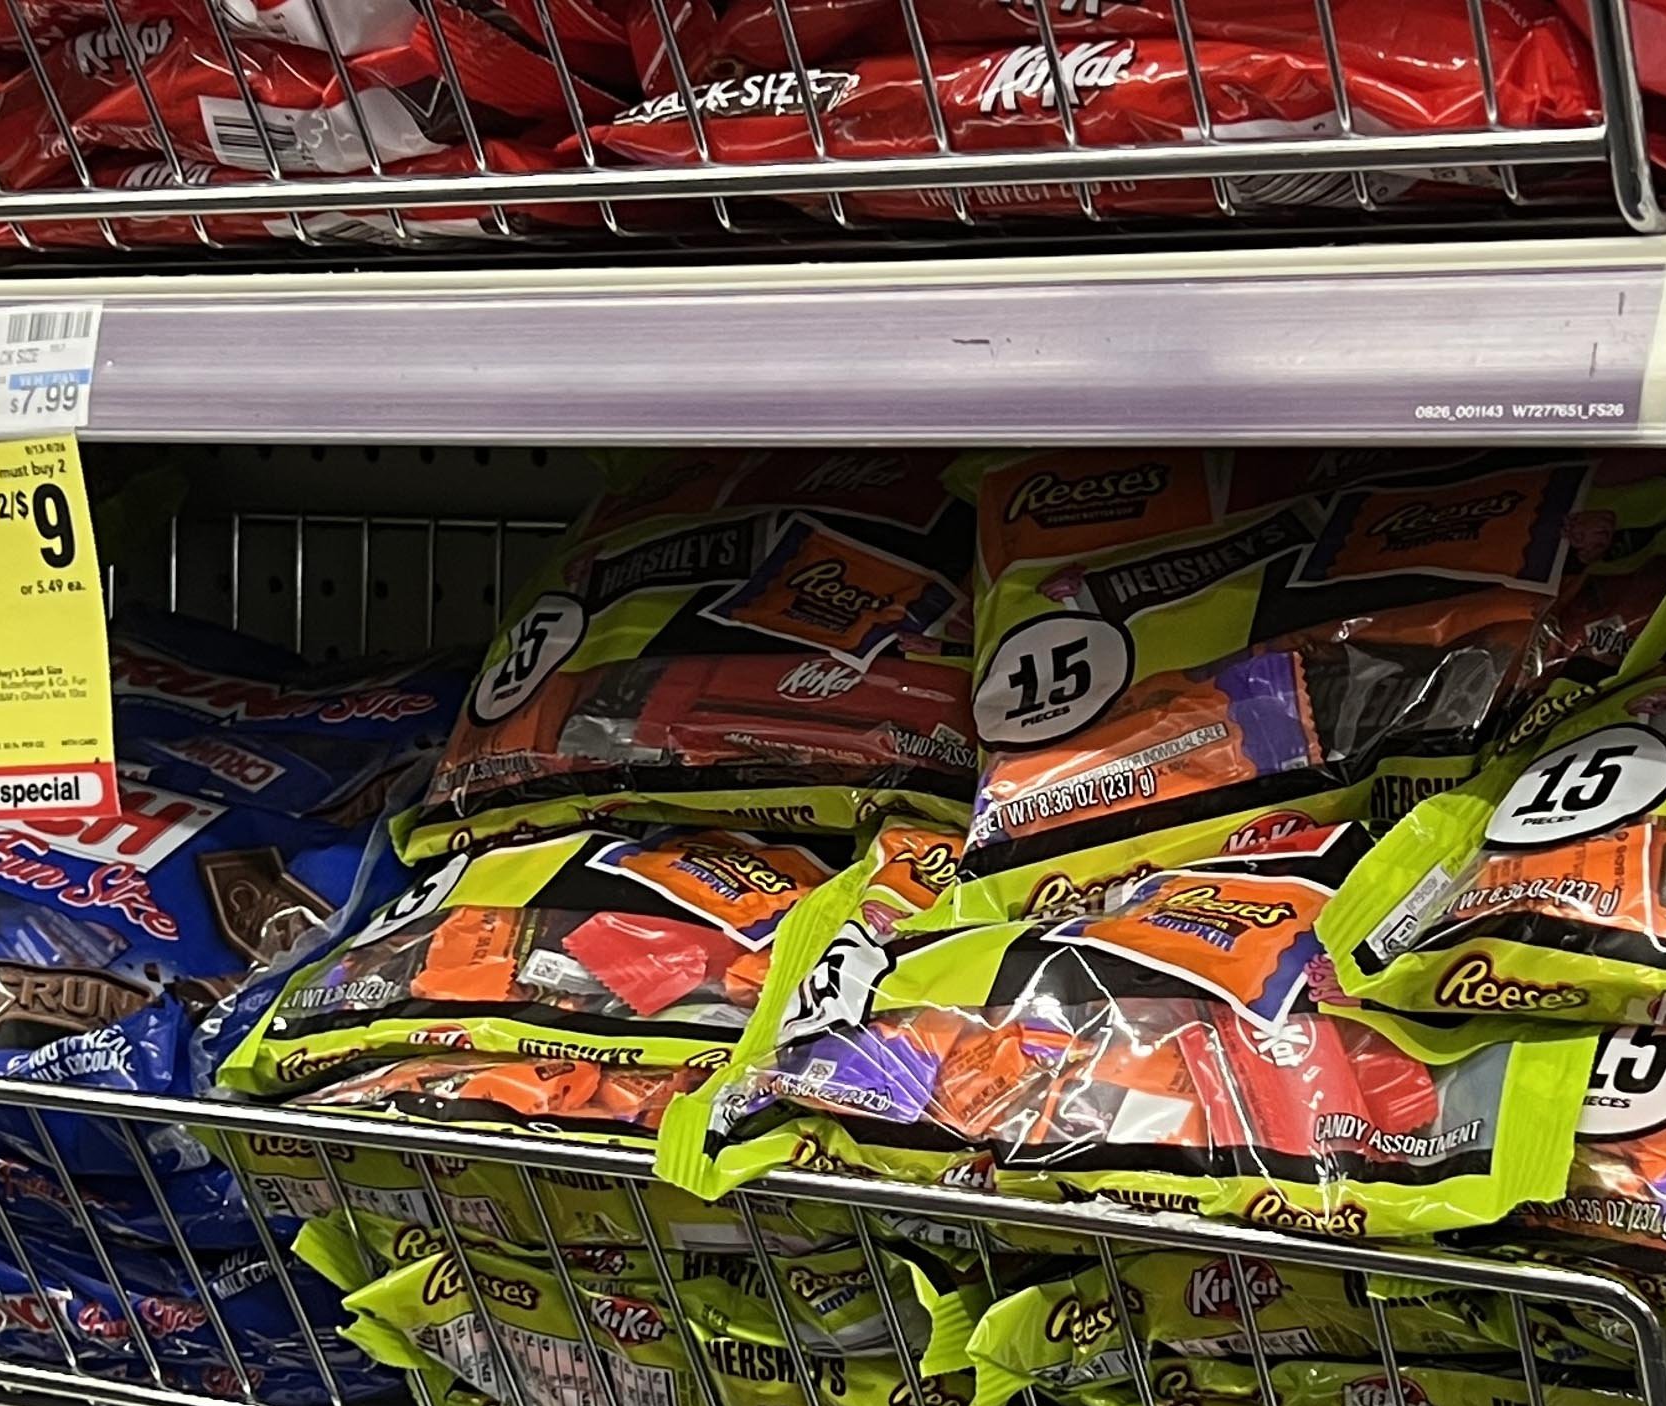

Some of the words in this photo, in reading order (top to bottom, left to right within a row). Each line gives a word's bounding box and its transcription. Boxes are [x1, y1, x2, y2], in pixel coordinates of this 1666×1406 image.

[9, 381, 79, 415] $7.99
[31, 461, 55, 479] buy
[1007, 464, 1168, 522] Reese's
[599, 530, 739, 598] HERSHEY'S
[1111, 520, 1288, 604] HERSHEY'S
[36, 579, 64, 595] 5.49
[1004, 636, 1093, 723] 15
[1021, 704, 1072, 728] PIECES
[1194, 725, 1226, 747] SALE
[0, 775, 81, 808] special
[1006, 795, 1037, 826] WT
[1037, 784, 1073, 821] 8.36
[1073, 777, 1099, 808] OZ
[1100, 769, 1136, 806] (237
[1510, 744, 1640, 820] 15
[61, 862, 180, 942] Size
[1165, 884, 1297, 928] Reese's
[1439, 958, 1588, 1012] Reese's
[1313, 1112, 1368, 1145] CANDY
[1368, 1119, 1482, 1158] ASSORTMENT
[1566, 1197, 1604, 1225] 8.36
[590, 1297, 667, 1344] KitKat
